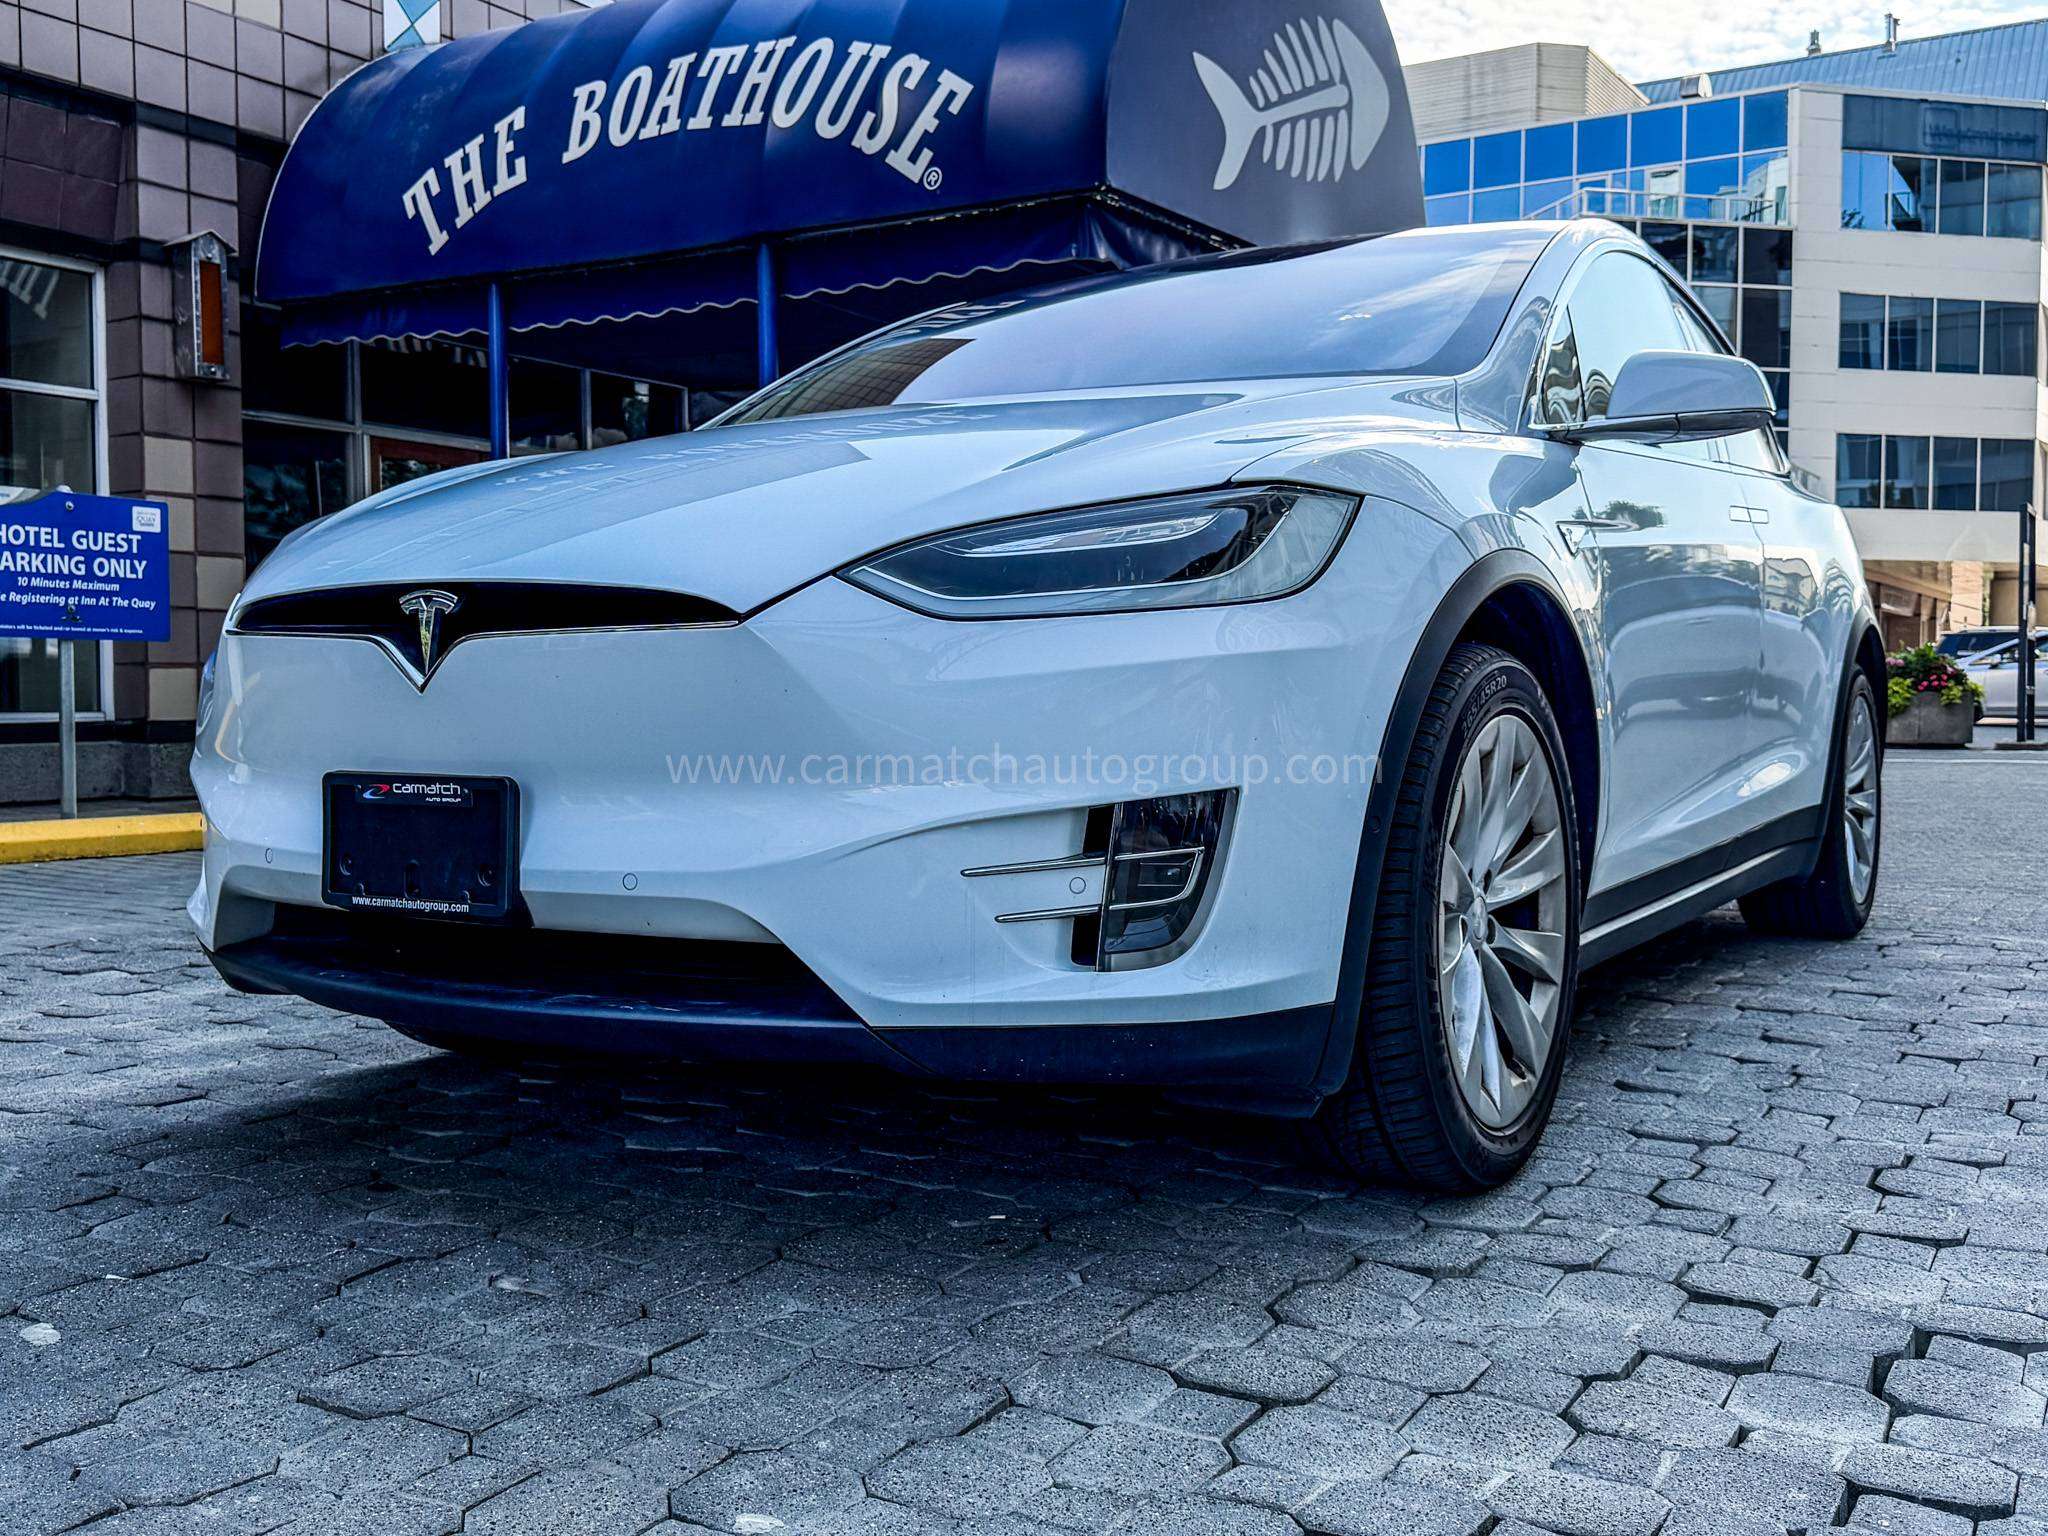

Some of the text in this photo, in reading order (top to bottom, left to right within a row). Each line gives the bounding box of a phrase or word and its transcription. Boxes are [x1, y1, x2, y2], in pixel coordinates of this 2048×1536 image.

[402, 106, 527, 256] THE
[561, 36, 974, 184] BOATHOUSE
[71, 530, 142, 554] GUEST
[0, 551, 147, 579] ARKING ONLY
[17, 576, 120, 592] 10 Minutes Maximum
[9, 591, 65, 606] Registering
[67, 596, 79, 606] at
[81, 595, 97, 606] Inn
[98, 597, 110, 607] At
[112, 597, 130, 608] The
[131, 598, 157, 610] Quay
[352, 895, 469, 912] www.carmatchautogroup.com
